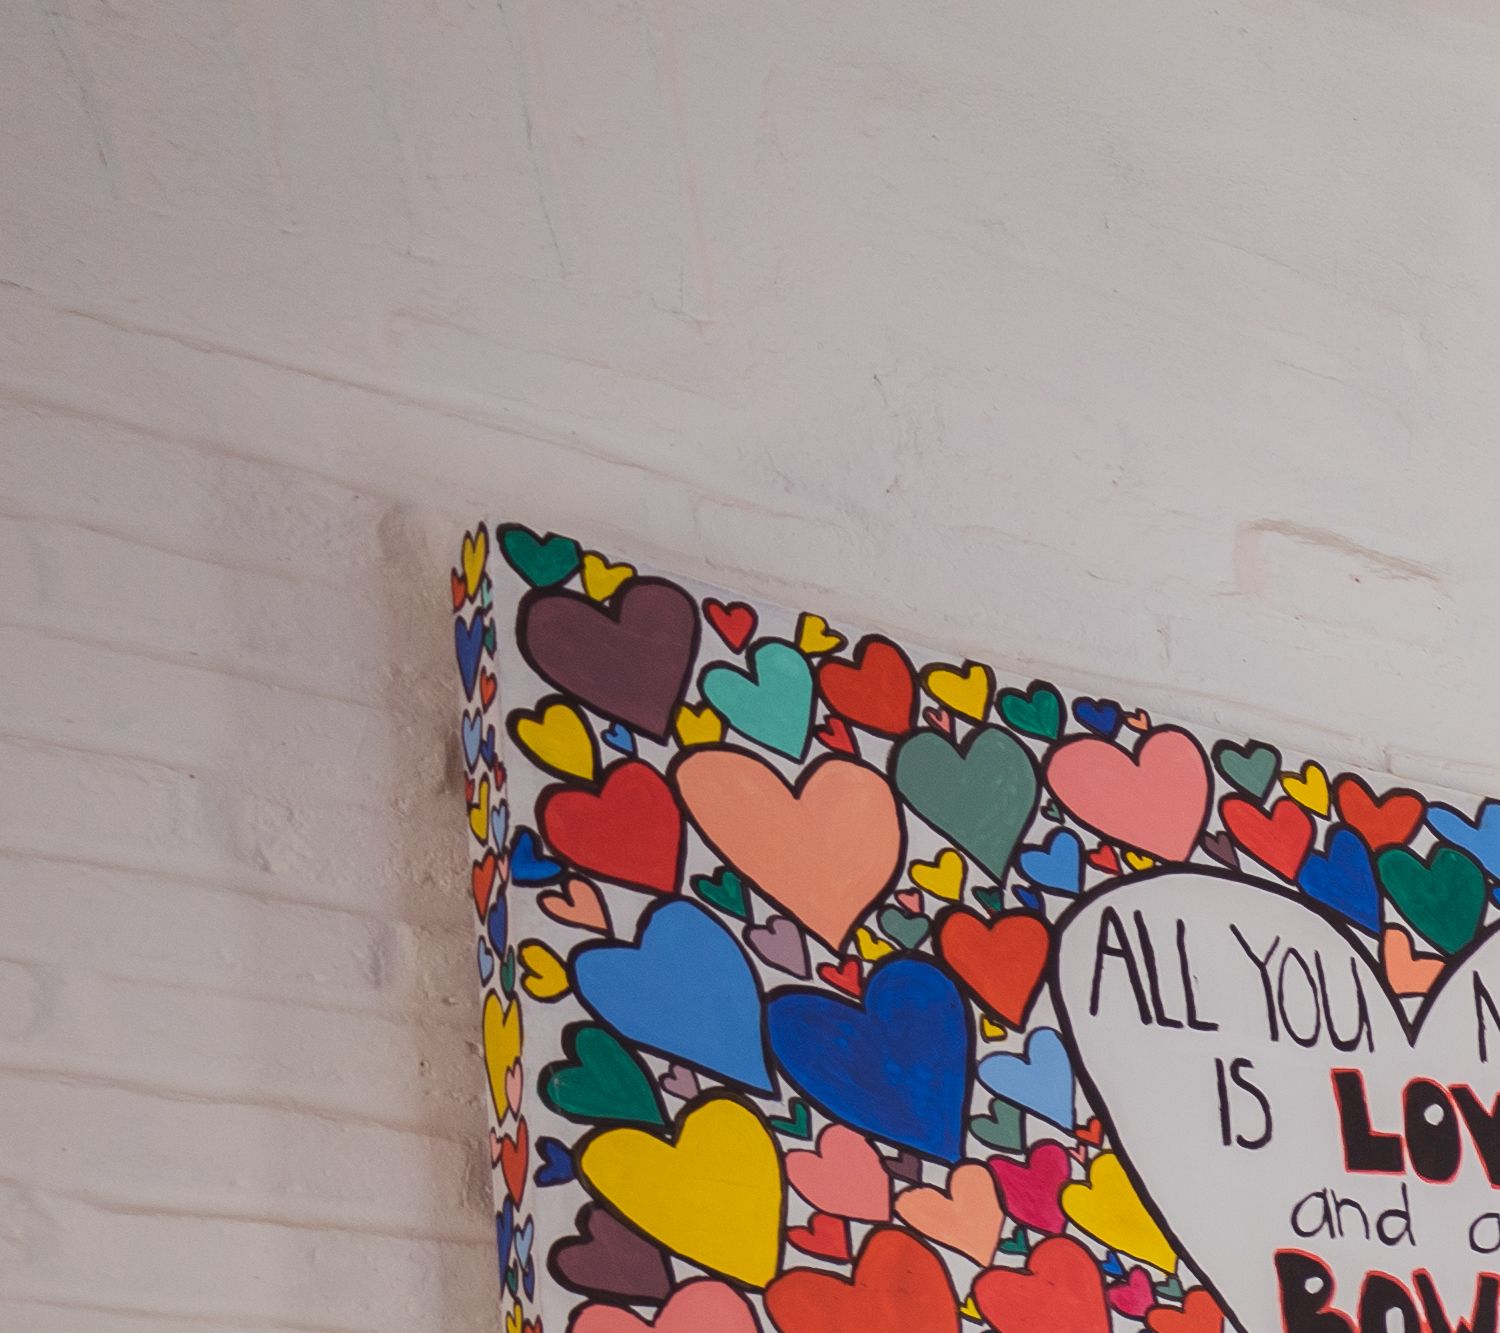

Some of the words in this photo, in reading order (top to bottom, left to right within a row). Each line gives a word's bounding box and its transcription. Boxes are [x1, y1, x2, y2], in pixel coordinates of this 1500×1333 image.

[1089, 906, 1219, 1031] ALL
[1231, 923, 1374, 1053] YOU
[1215, 1057, 1273, 1149] IS
[1290, 1182, 1416, 1248] and
